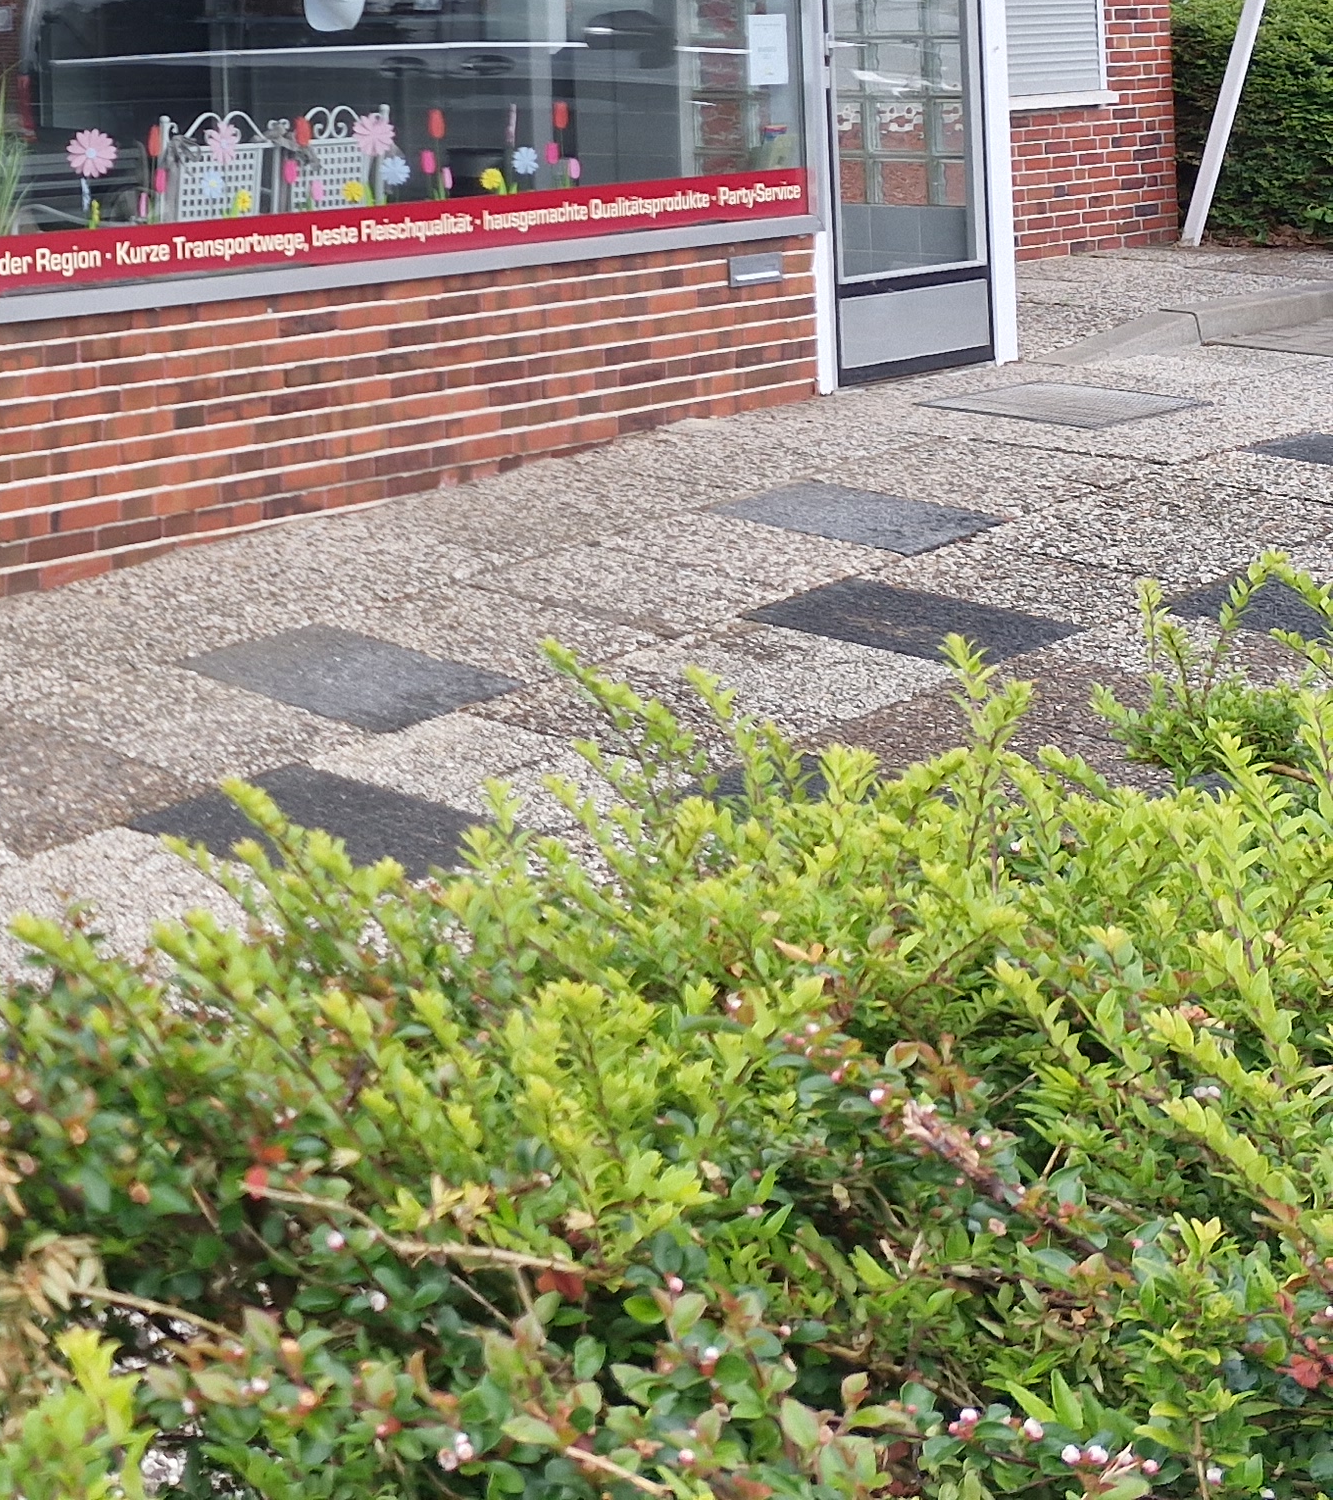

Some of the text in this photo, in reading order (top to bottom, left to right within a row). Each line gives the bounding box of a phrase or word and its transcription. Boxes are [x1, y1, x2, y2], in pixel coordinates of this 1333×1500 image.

[36, 245, 102, 277] Region
[116, 241, 170, 265] Kurze
[172, 232, 309, 261] Transportwege,
[311, 224, 359, 247] beste
[361, 212, 474, 243] Fleischqualität
[483, 202, 588, 232] hausgemachte
[589, 190, 710, 219] Qualitätsprodukte
